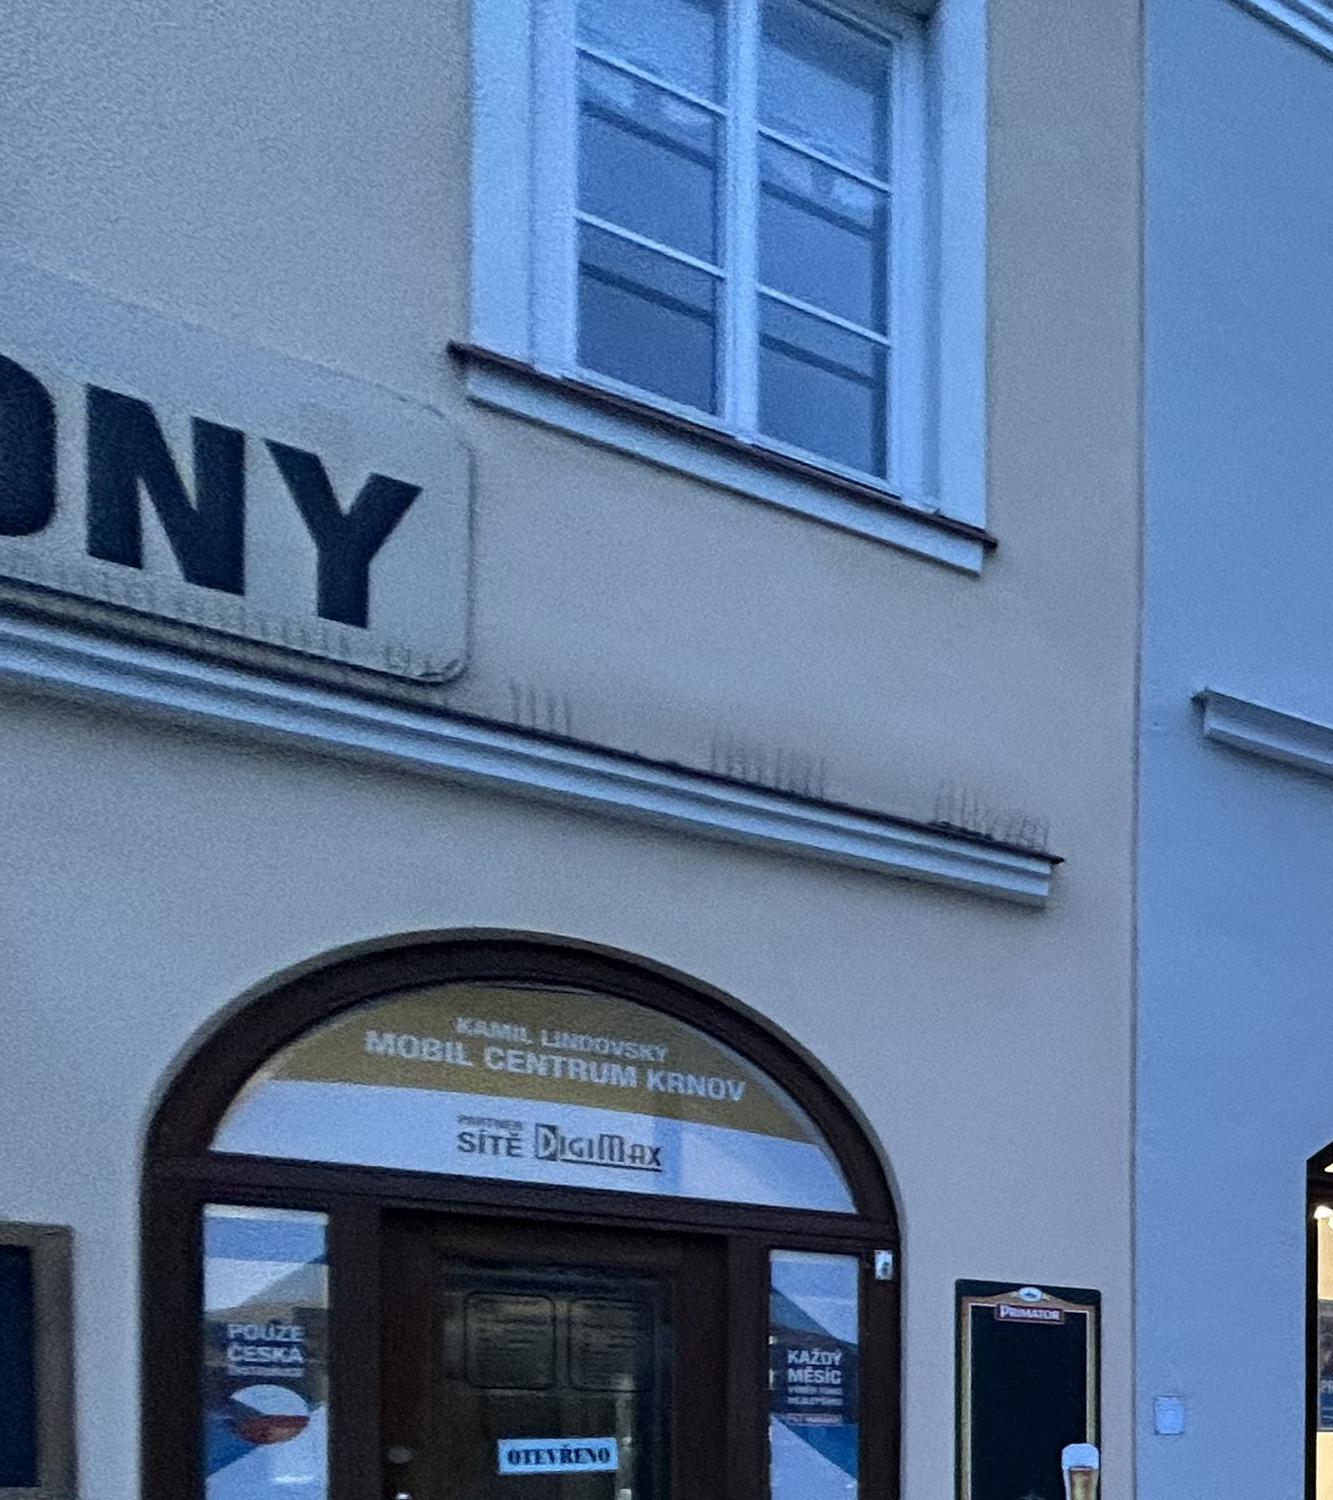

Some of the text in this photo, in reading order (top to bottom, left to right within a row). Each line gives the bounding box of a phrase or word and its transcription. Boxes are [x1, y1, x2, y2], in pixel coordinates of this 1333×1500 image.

[454, 1017, 533, 1045] KAMIL
[364, 1030, 746, 1101] MOBIL CENTRUM KRNOV
[457, 1129, 523, 1157] SÍTĚ
[787, 1348, 842, 1366] KAŽDÝ
[787, 1366, 842, 1385] MĚSÍC
[508, 1444, 610, 1465] OTEVŘENO
